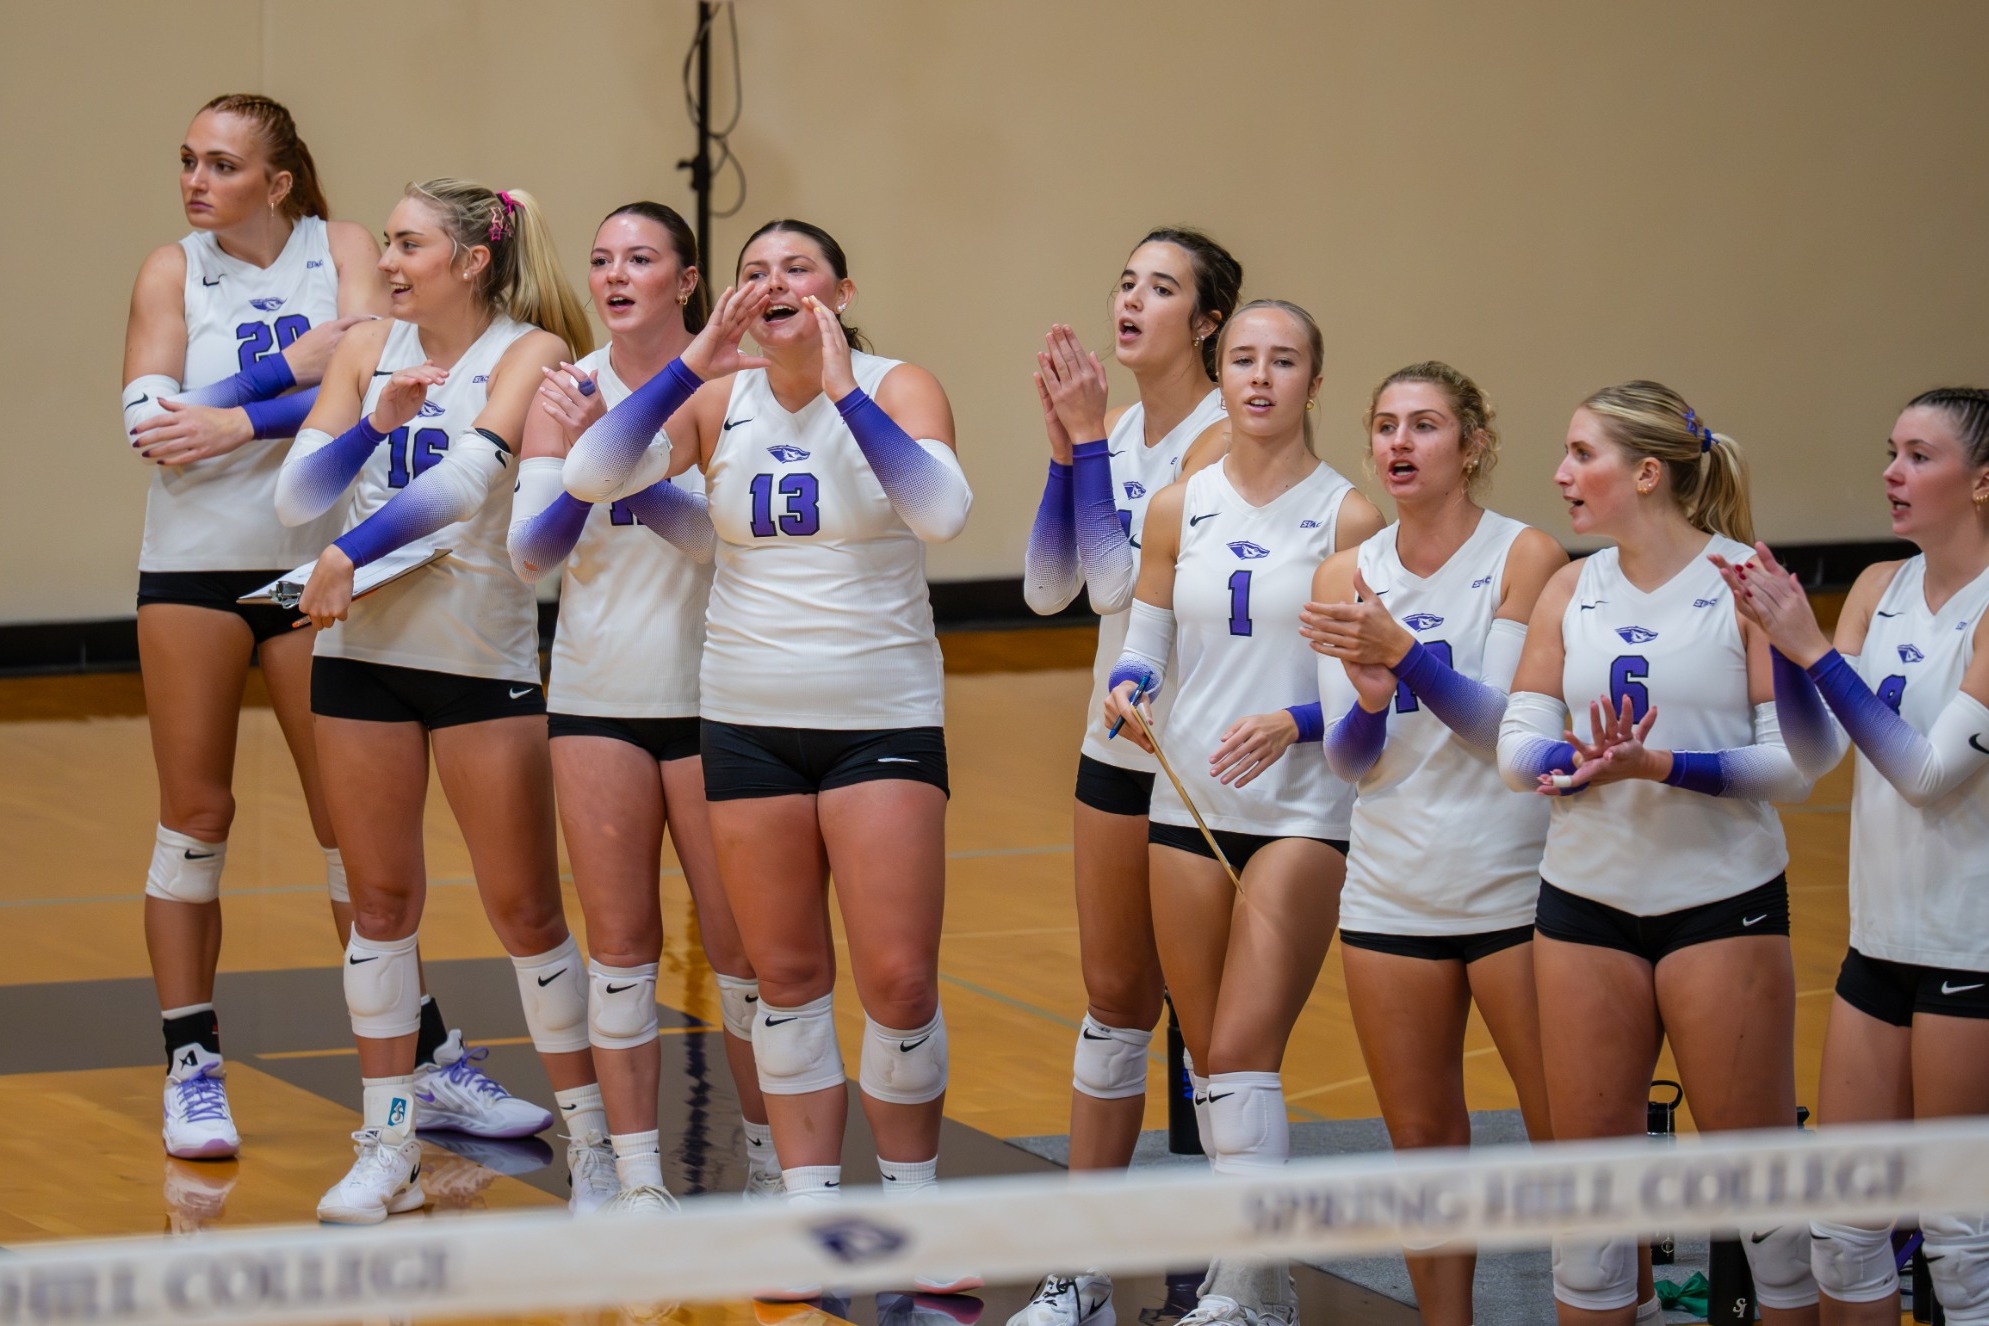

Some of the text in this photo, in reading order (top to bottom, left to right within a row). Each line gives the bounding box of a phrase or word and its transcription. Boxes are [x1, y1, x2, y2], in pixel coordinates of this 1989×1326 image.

[388, 425, 450, 489] 16
[749, 472, 821, 538] 13
[1228, 569, 1252, 637] 1
[1609, 655, 1659, 726] 6
[1484, 1164, 1618, 1228] HILL
[1640, 1149, 1910, 1219] COLLEGE
[163, 1247, 450, 1318] COLLEGE
